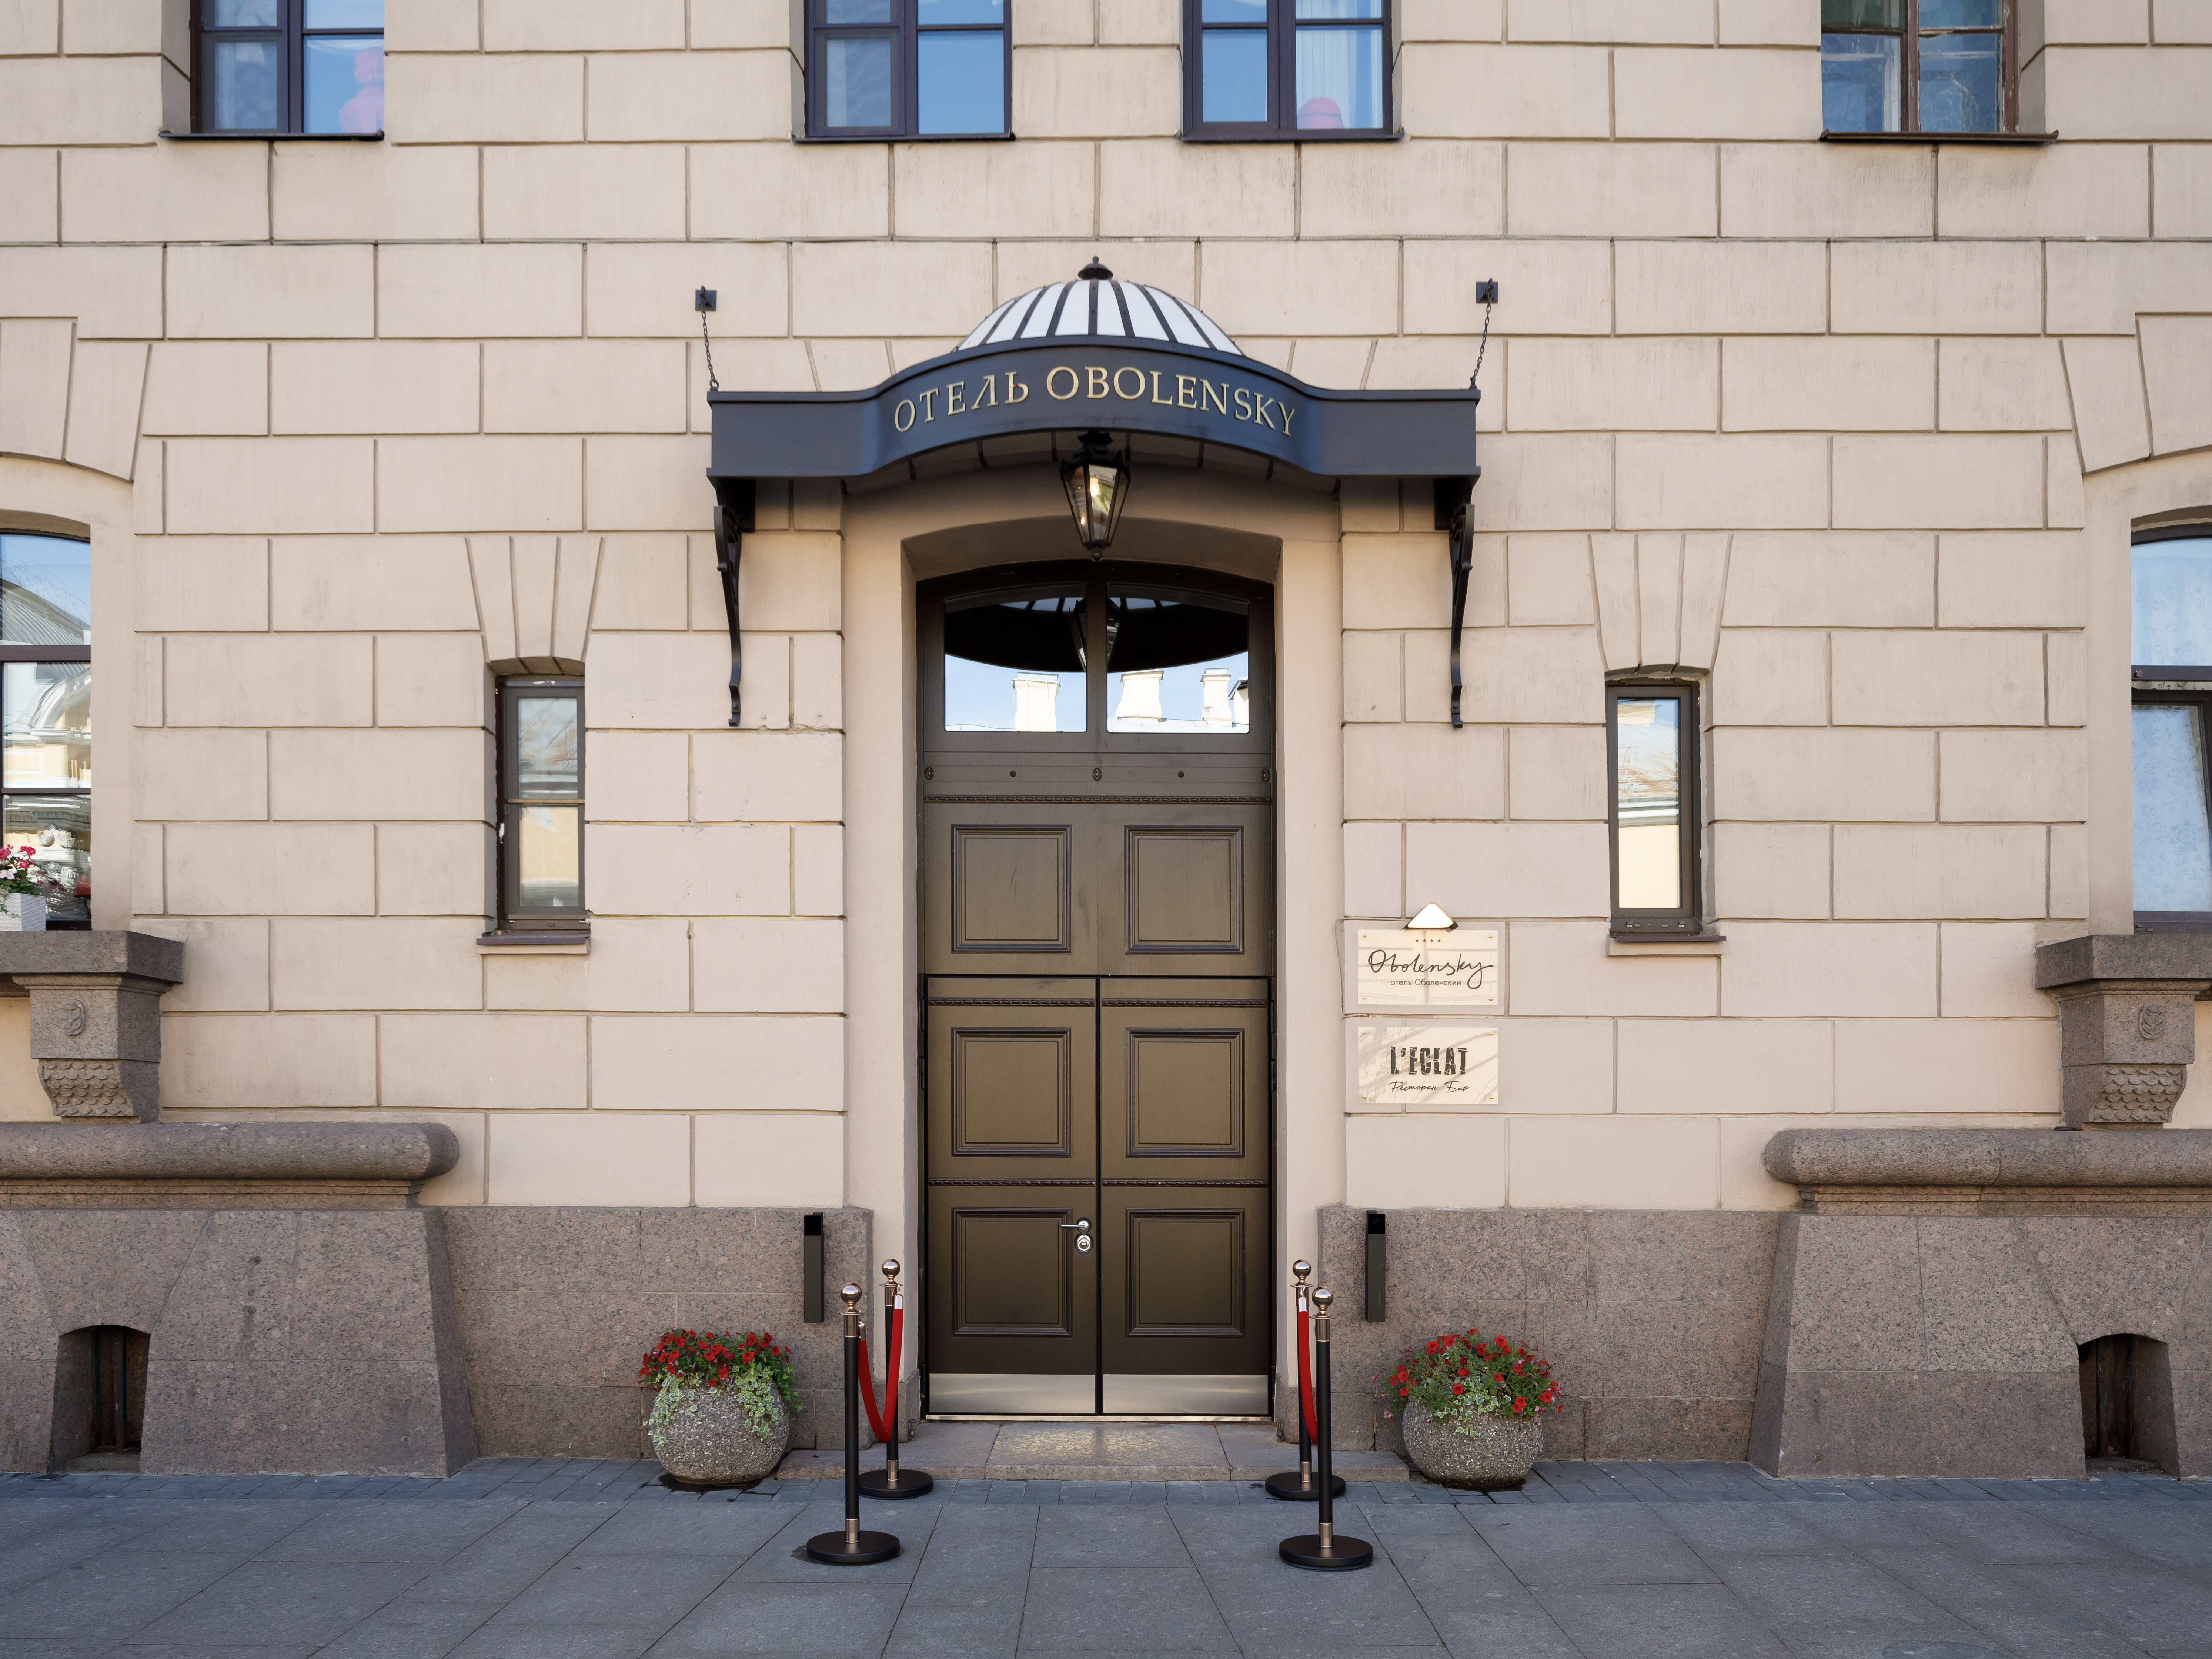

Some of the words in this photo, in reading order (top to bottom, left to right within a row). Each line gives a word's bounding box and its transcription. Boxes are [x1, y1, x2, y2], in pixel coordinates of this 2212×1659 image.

[894, 371, 1029, 432] ОТЕЛЬ
[1046, 366, 1296, 437] OBOLENSKY
[1368, 949, 1494, 989] Obolensky
[1415, 978, 1461, 986] Оболенский
[1388, 1081, 1438, 1092] Ресторан
[1444, 1081, 1470, 1093] Бар
